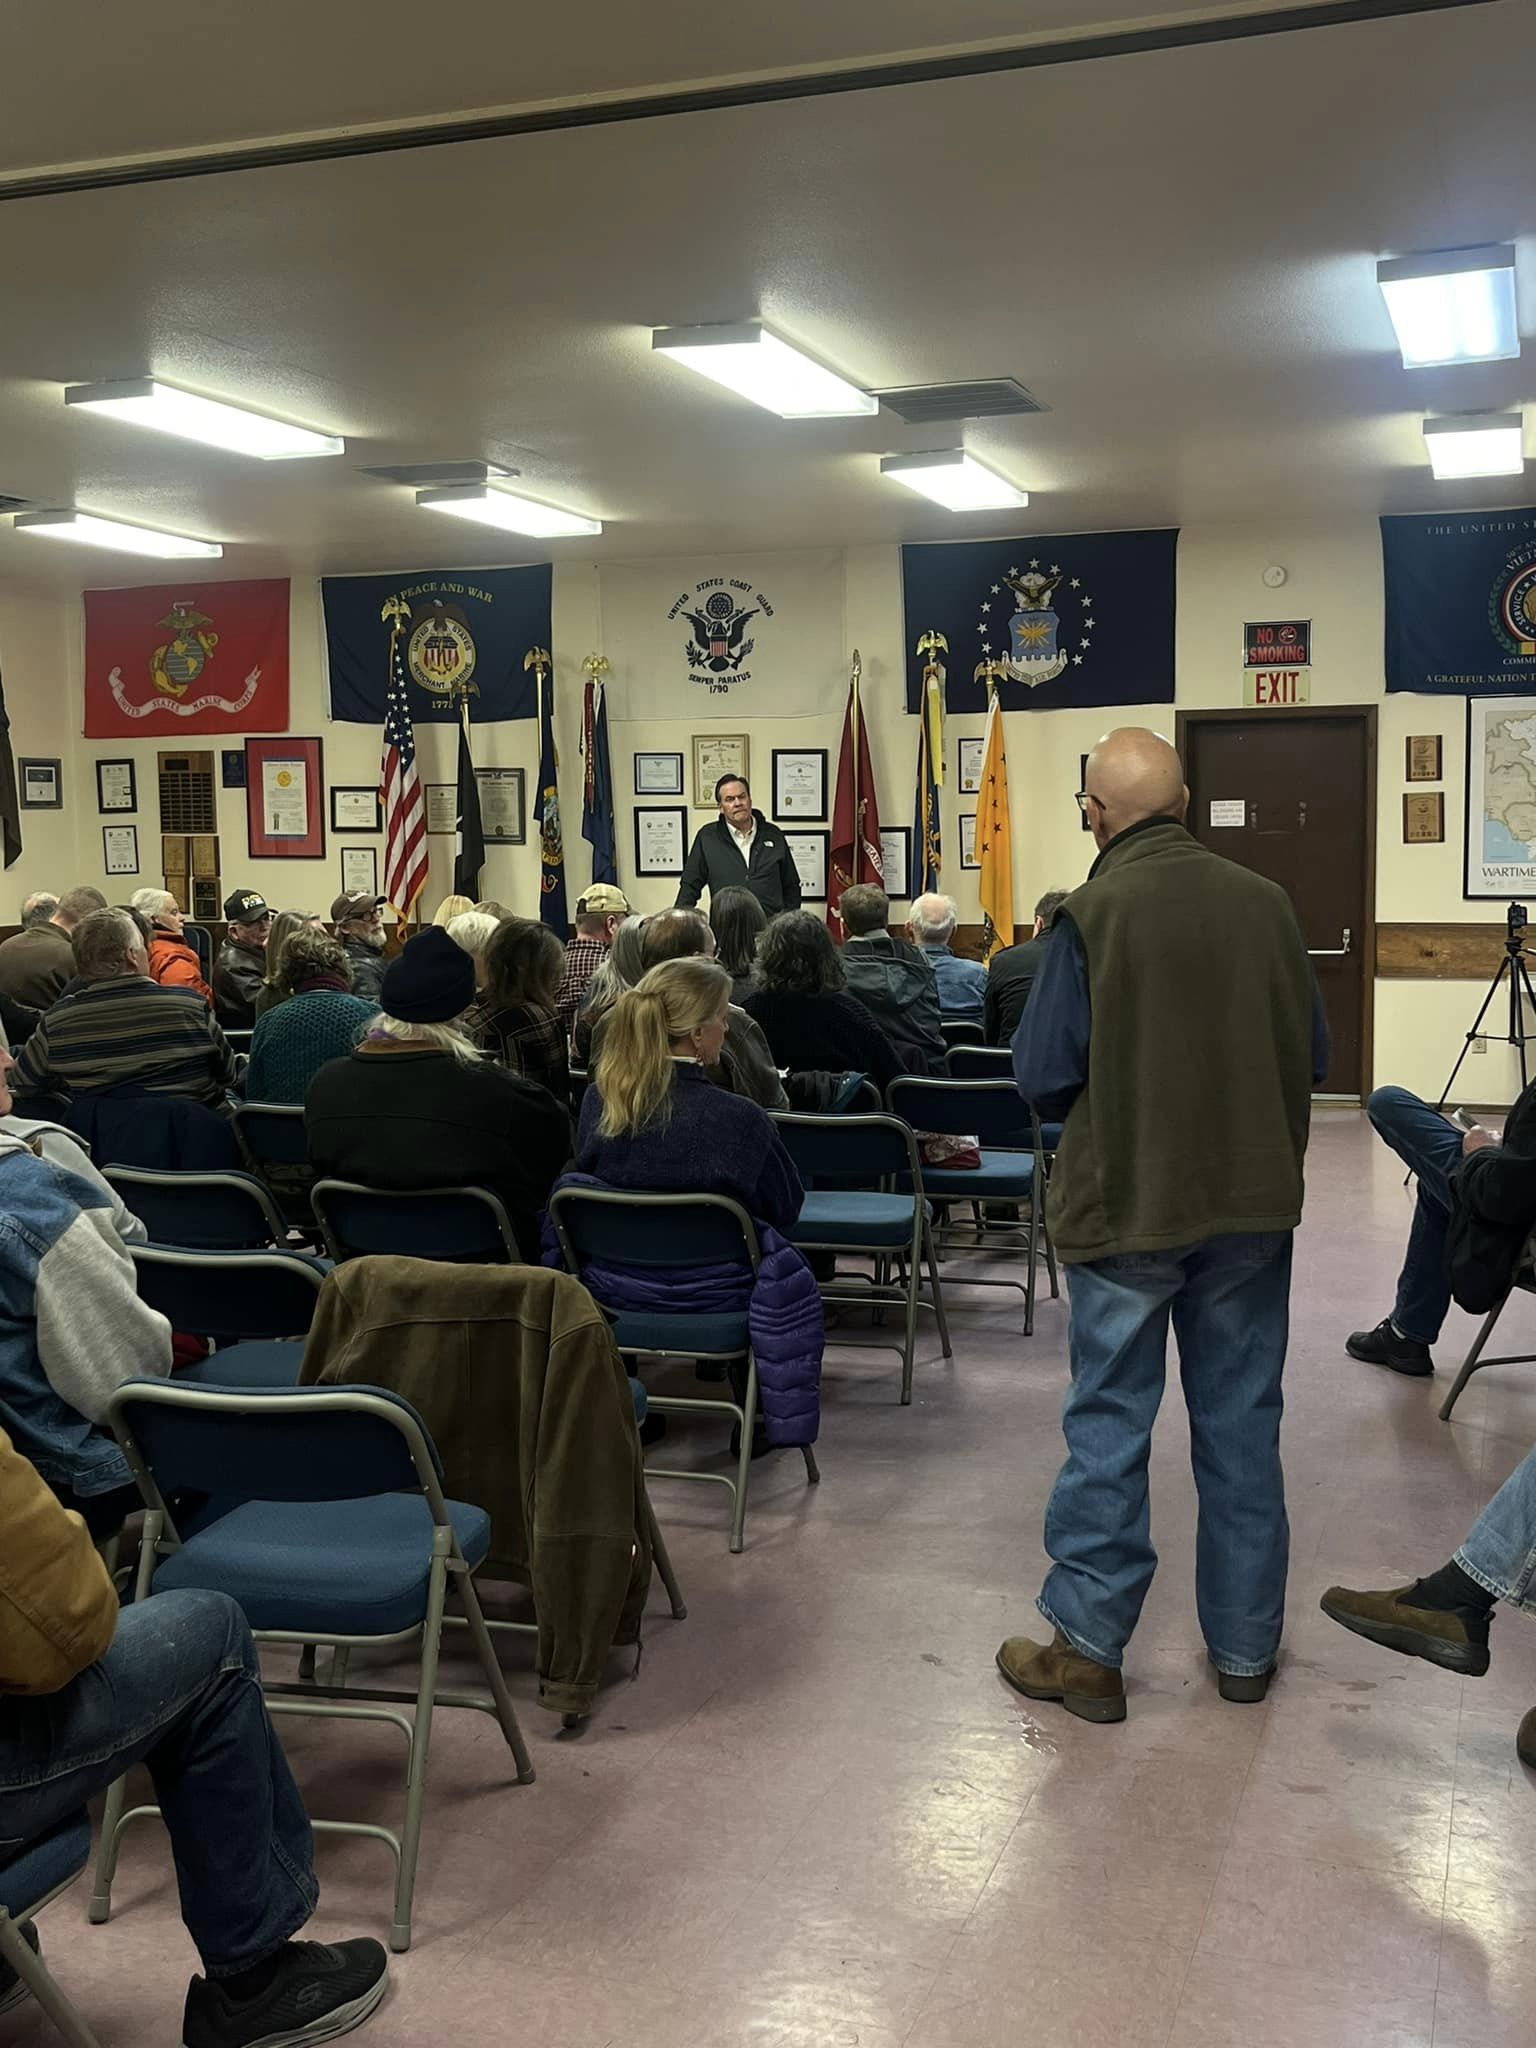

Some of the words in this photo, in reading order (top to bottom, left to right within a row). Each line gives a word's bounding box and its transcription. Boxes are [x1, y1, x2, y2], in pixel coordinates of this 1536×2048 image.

[1427, 526, 1452, 535] THE
[1460, 522, 1516, 535] UNITED
[400, 582, 437, 600] PEACE
[440, 582, 465, 593] AND
[467, 586, 493, 603] WAR
[667, 593, 689, 620] UNITED
[696, 578, 724, 592] STATES
[729, 579, 752, 593] COAST
[756, 594, 774, 617] GUARD
[1256, 627, 1274, 644] NO
[1249, 645, 1305, 664] SMOKING
[688, 673, 715, 685] SEMPER
[717, 671, 752, 685] PARATUS
[1434, 674, 1484, 684] GRATEFUL
[1487, 673, 1528, 684] NATION
[709, 684, 728, 694] 1790
[1255, 671, 1300, 704] EXIT
[192, 697, 222, 712] MARINE
[1481, 866, 1536, 878] WARTIME
